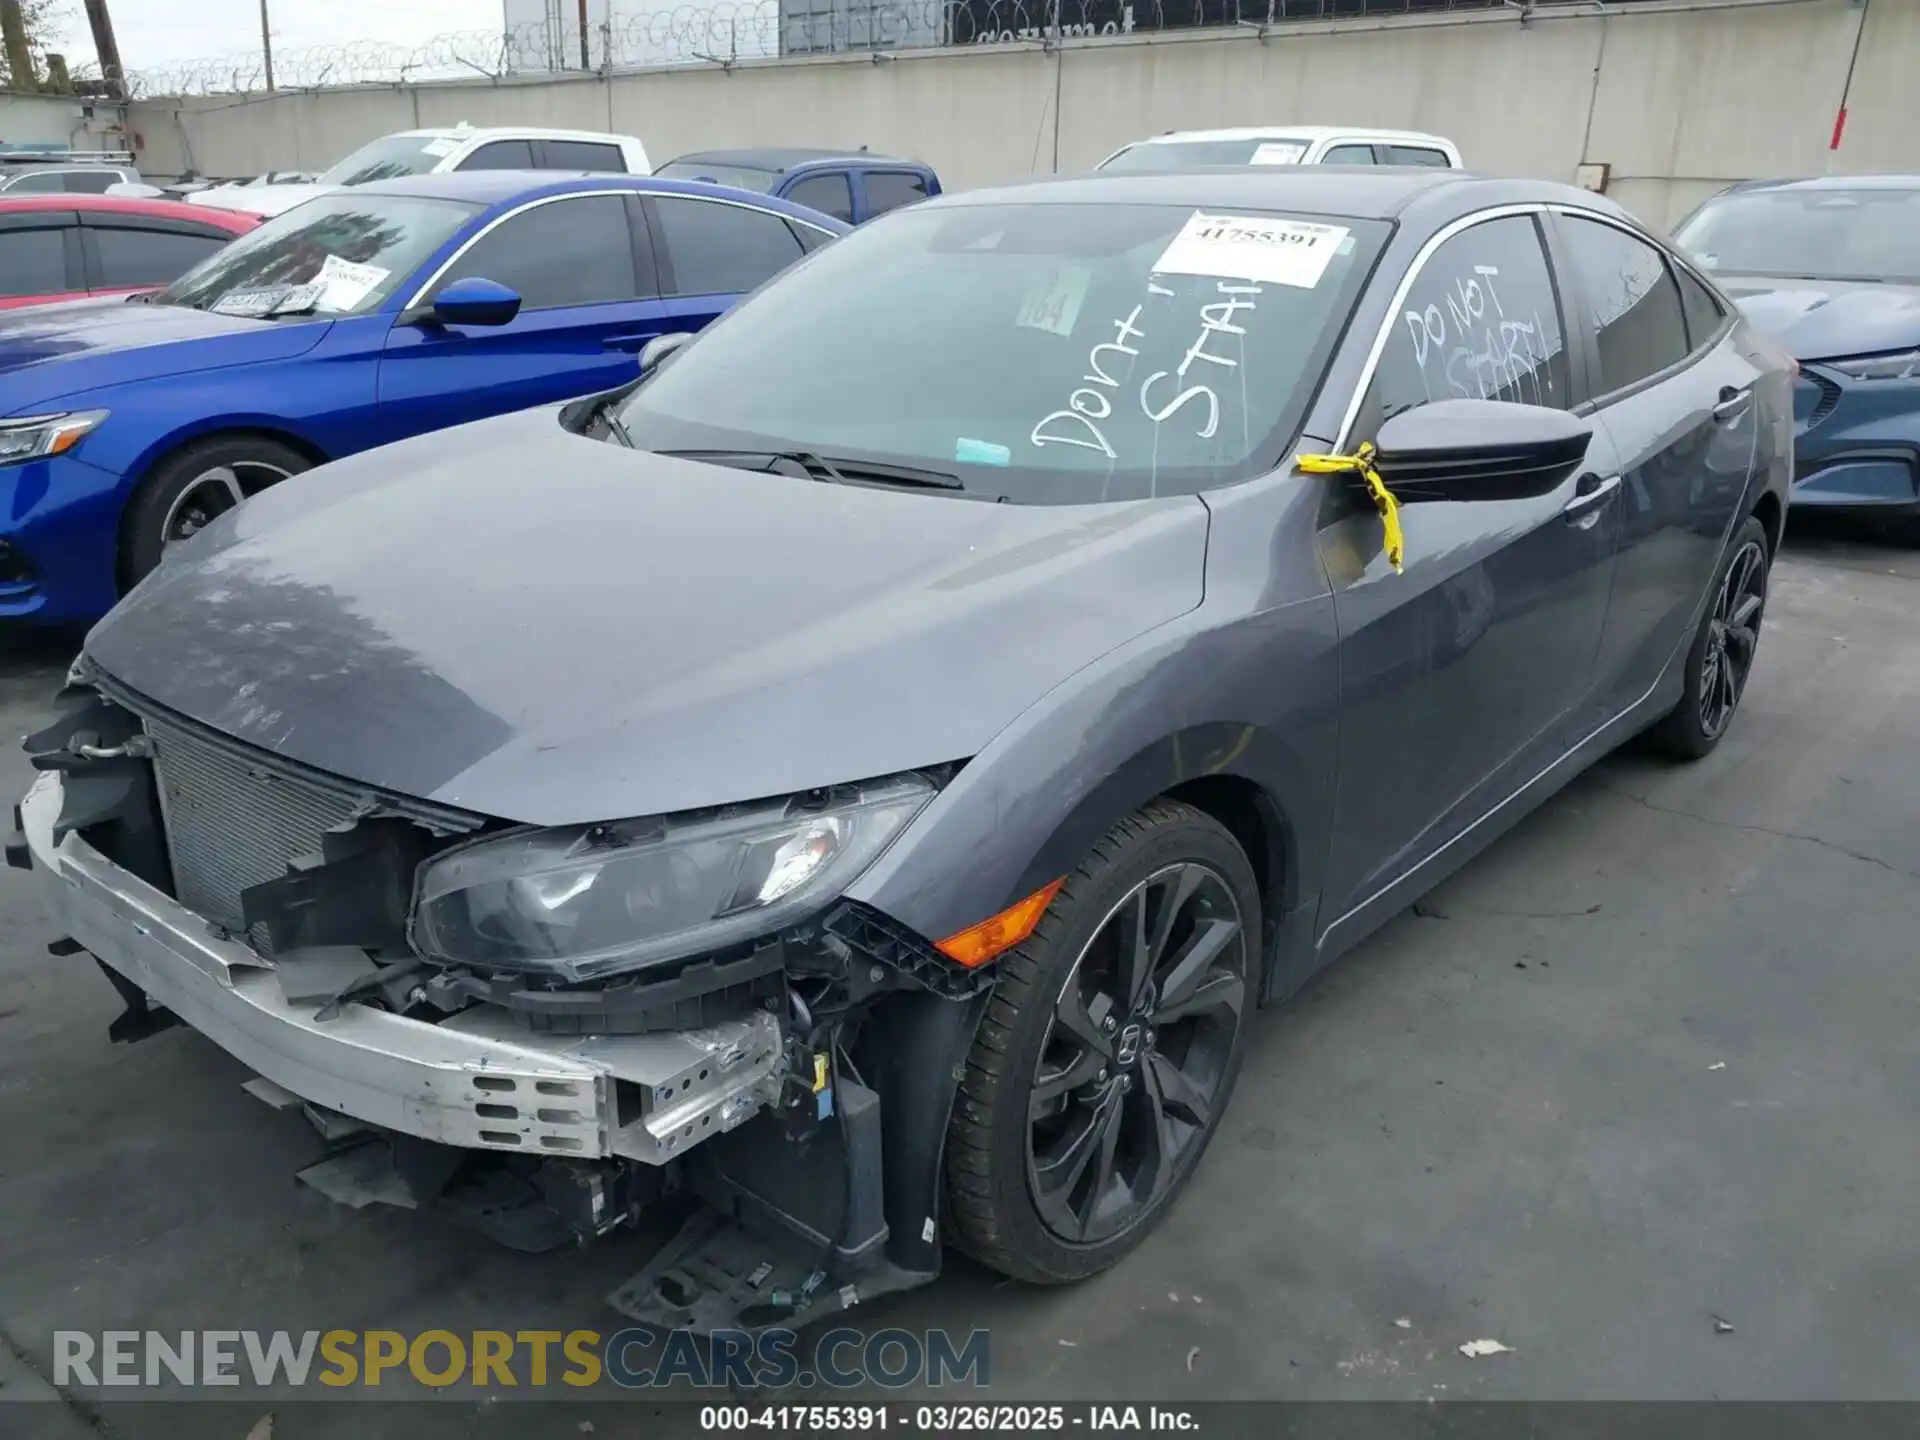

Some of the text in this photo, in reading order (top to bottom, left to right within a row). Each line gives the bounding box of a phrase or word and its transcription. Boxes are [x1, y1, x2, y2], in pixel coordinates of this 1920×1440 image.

[1196, 227, 1319, 247] 41755391
[1405, 265, 1504, 368] DO NOT
